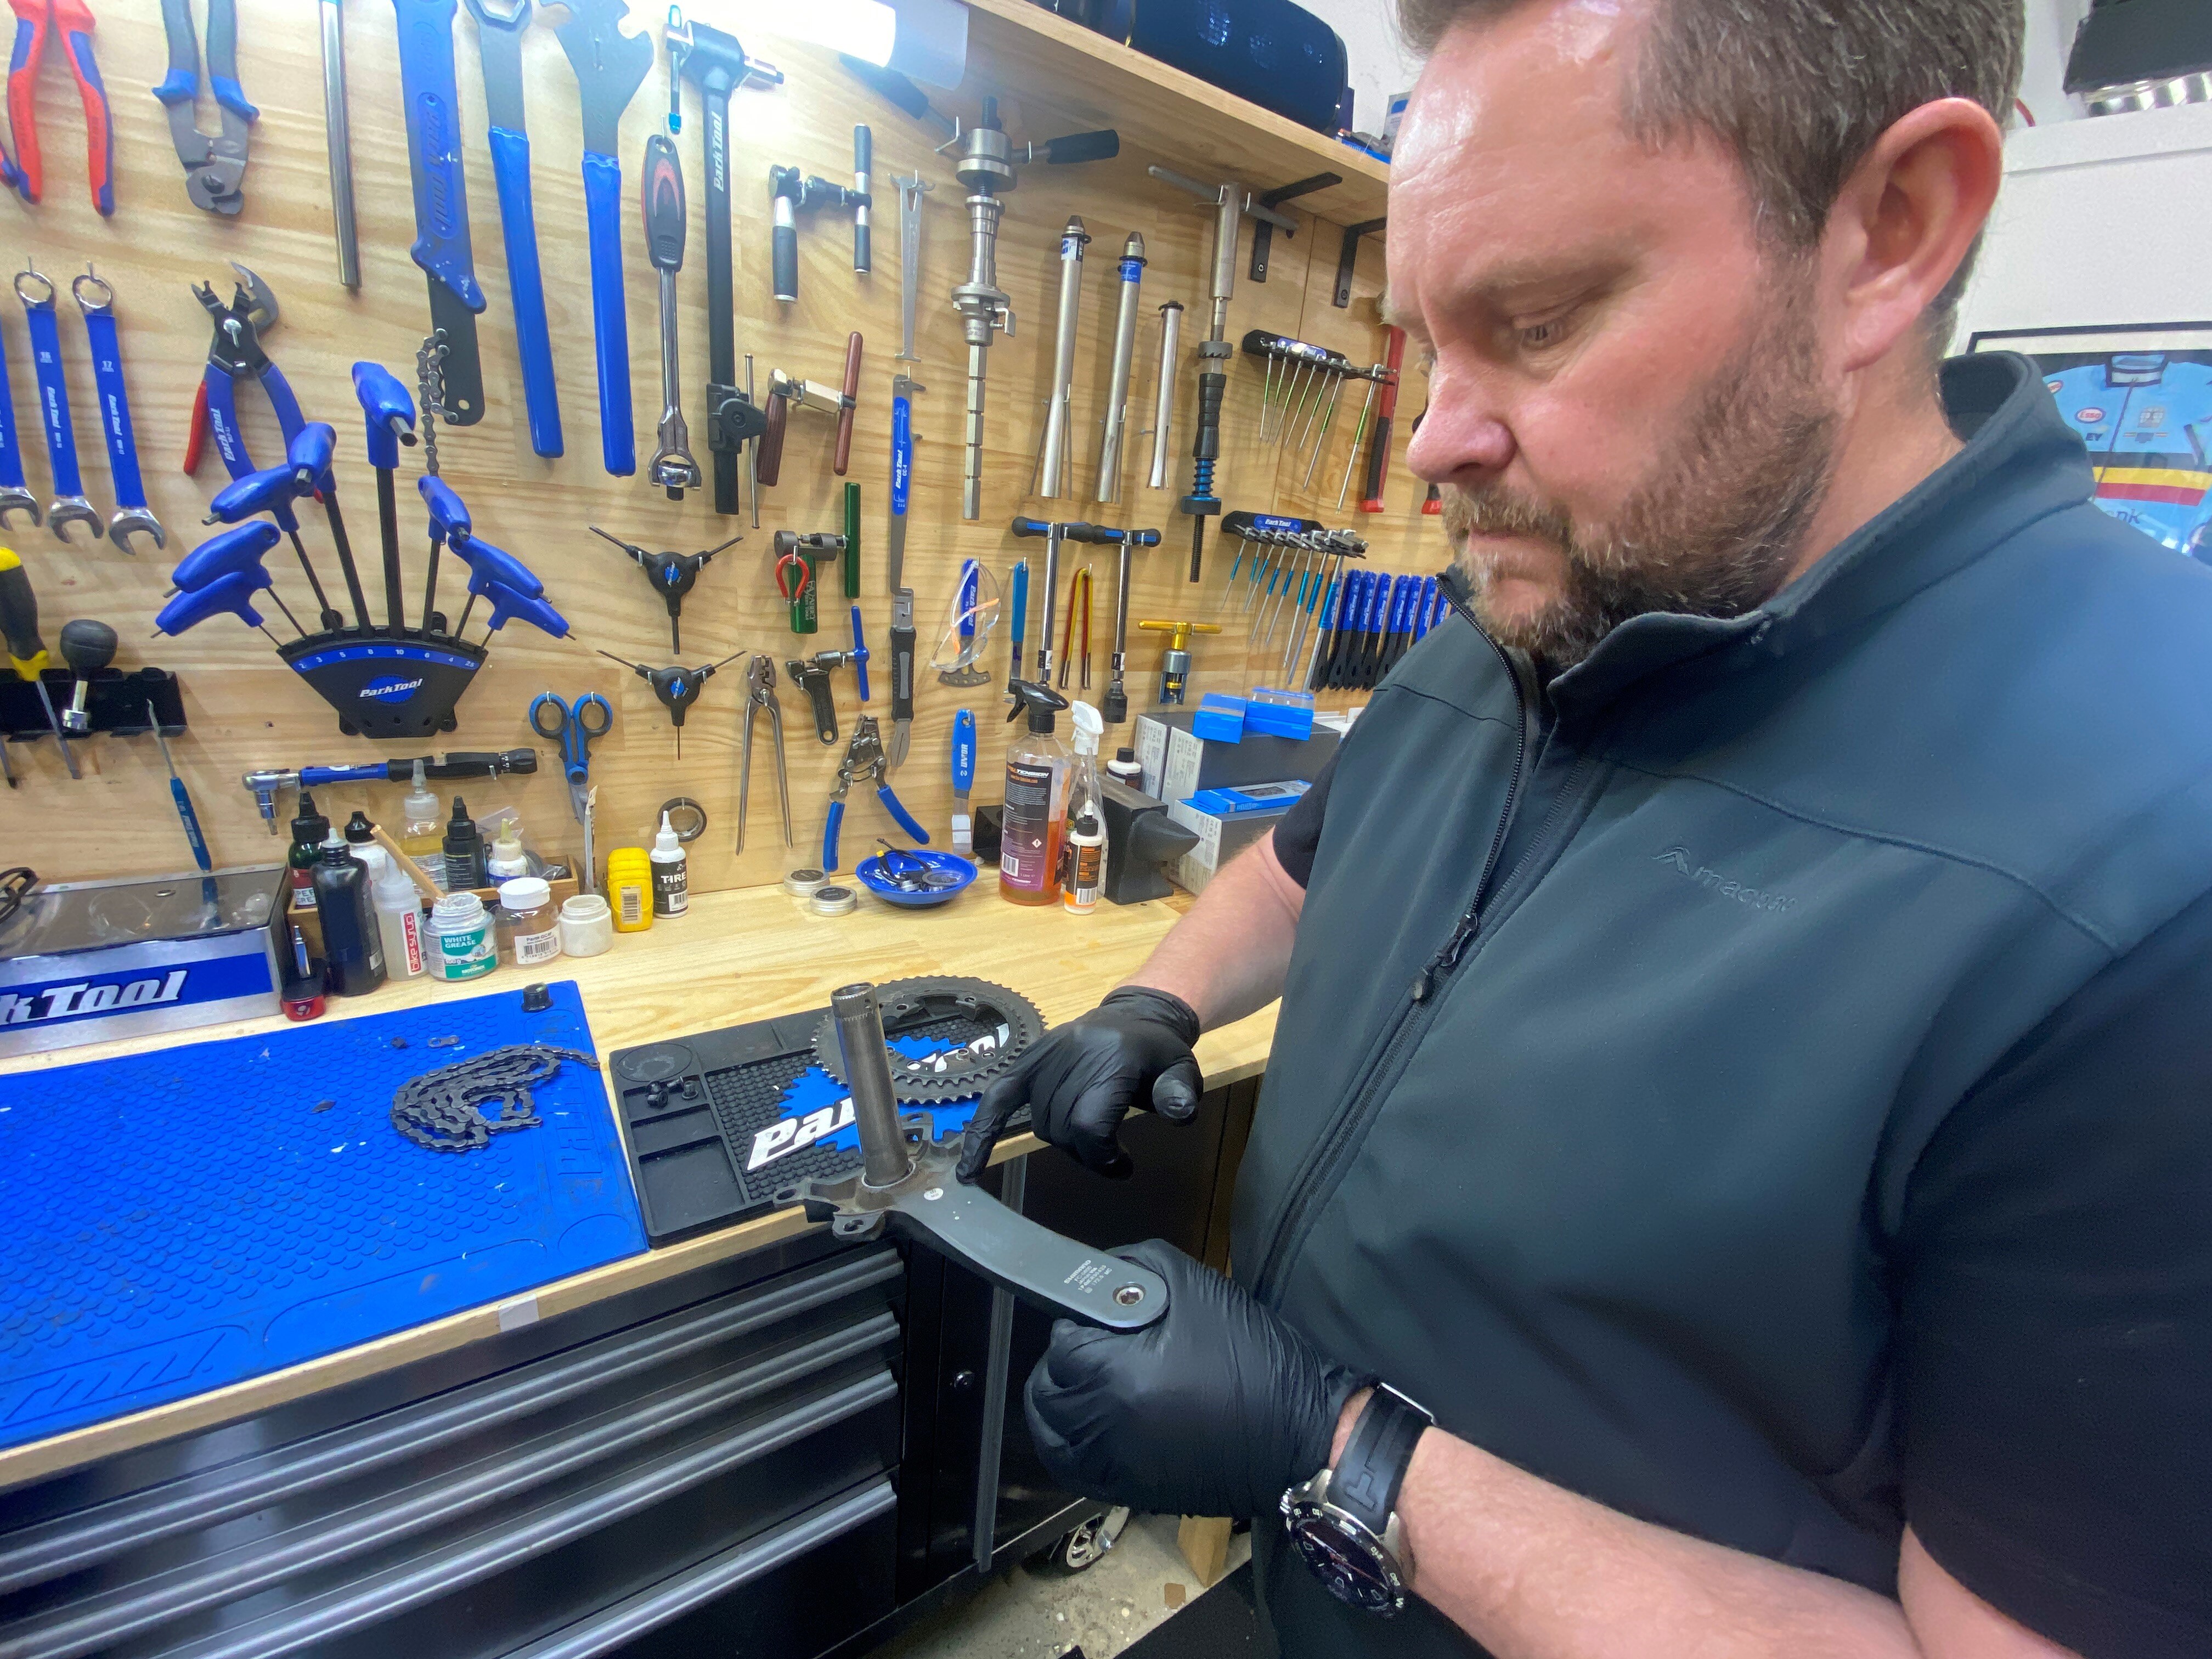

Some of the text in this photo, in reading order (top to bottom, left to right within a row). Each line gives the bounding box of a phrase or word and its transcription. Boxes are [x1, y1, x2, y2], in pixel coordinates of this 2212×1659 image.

[661, 871, 686, 884] TIRE
[406, 916, 420, 971] bike syrup
[444, 935, 472, 943] WHITE
[445, 939, 476, 948] GREASE
